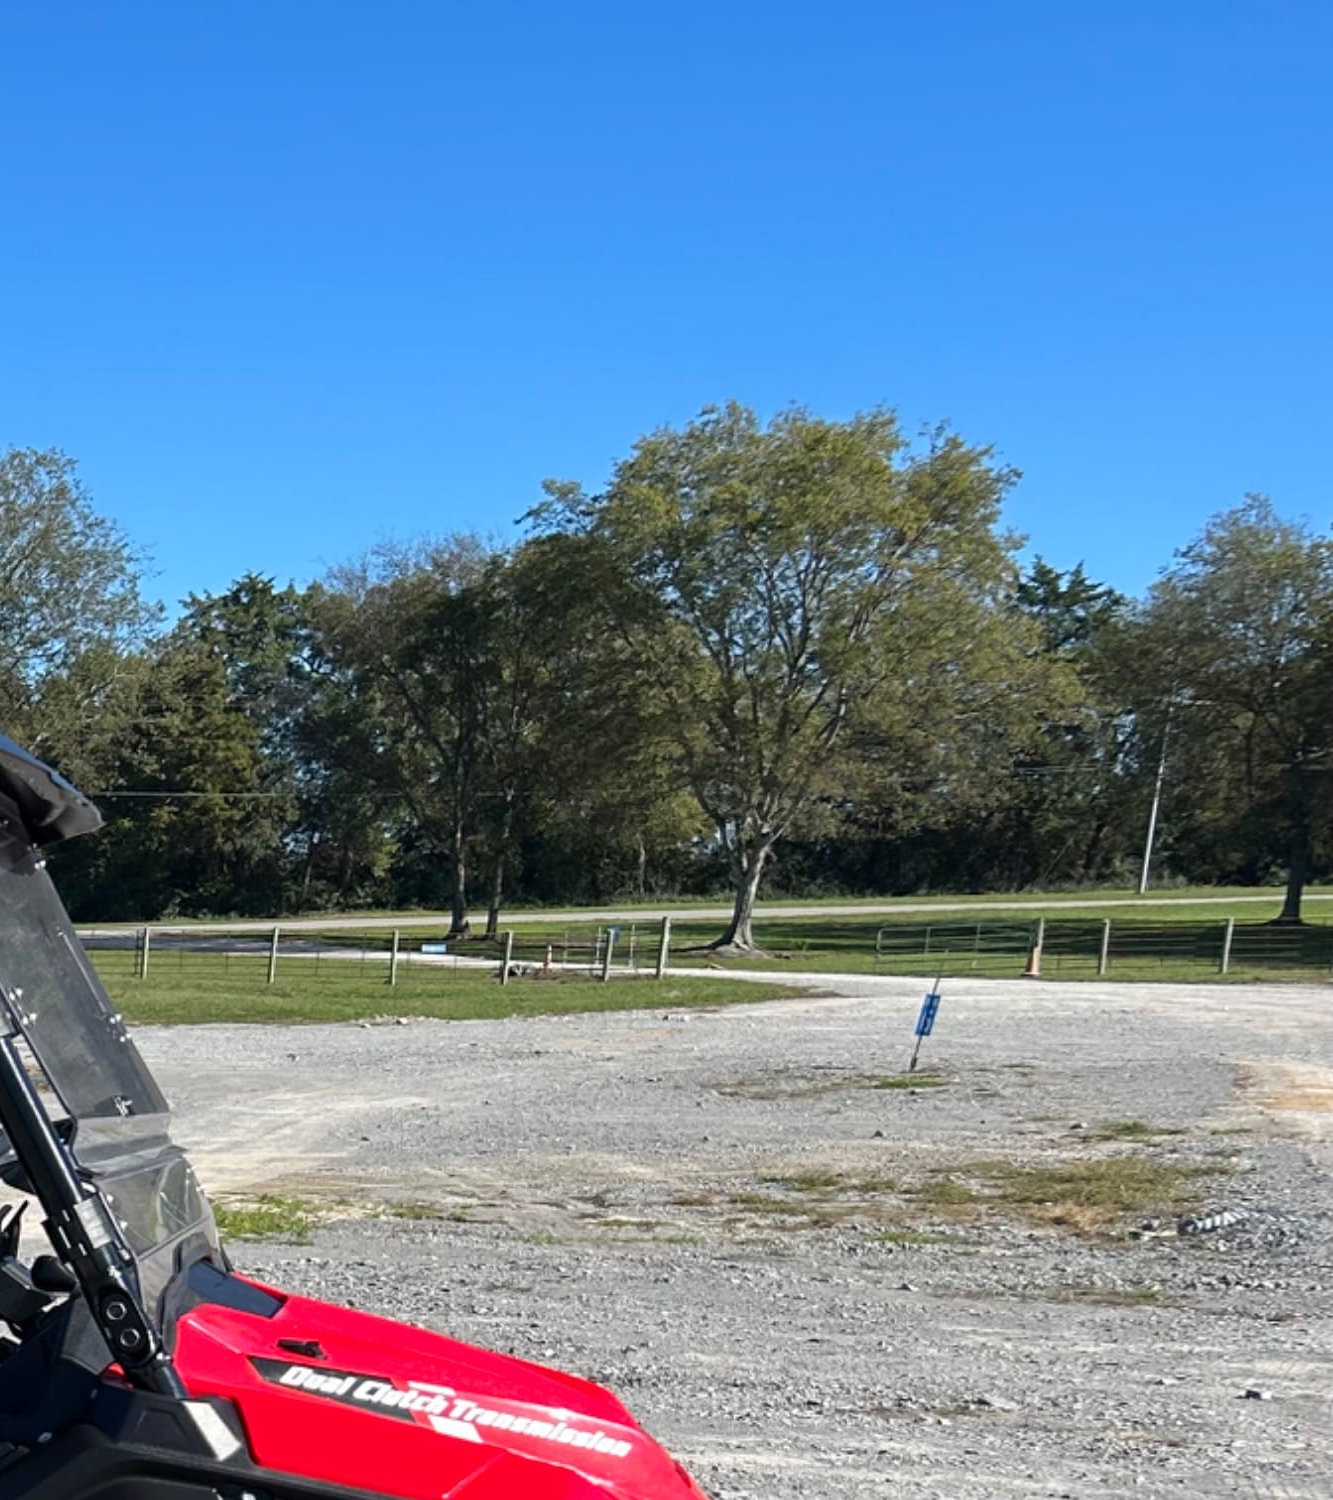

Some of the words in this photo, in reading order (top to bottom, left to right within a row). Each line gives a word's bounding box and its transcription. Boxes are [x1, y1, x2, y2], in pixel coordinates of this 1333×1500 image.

[279, 1365, 348, 1395] Dual
[352, 1379, 446, 1414] Clutch
[447, 1398, 633, 1458] Transmission
